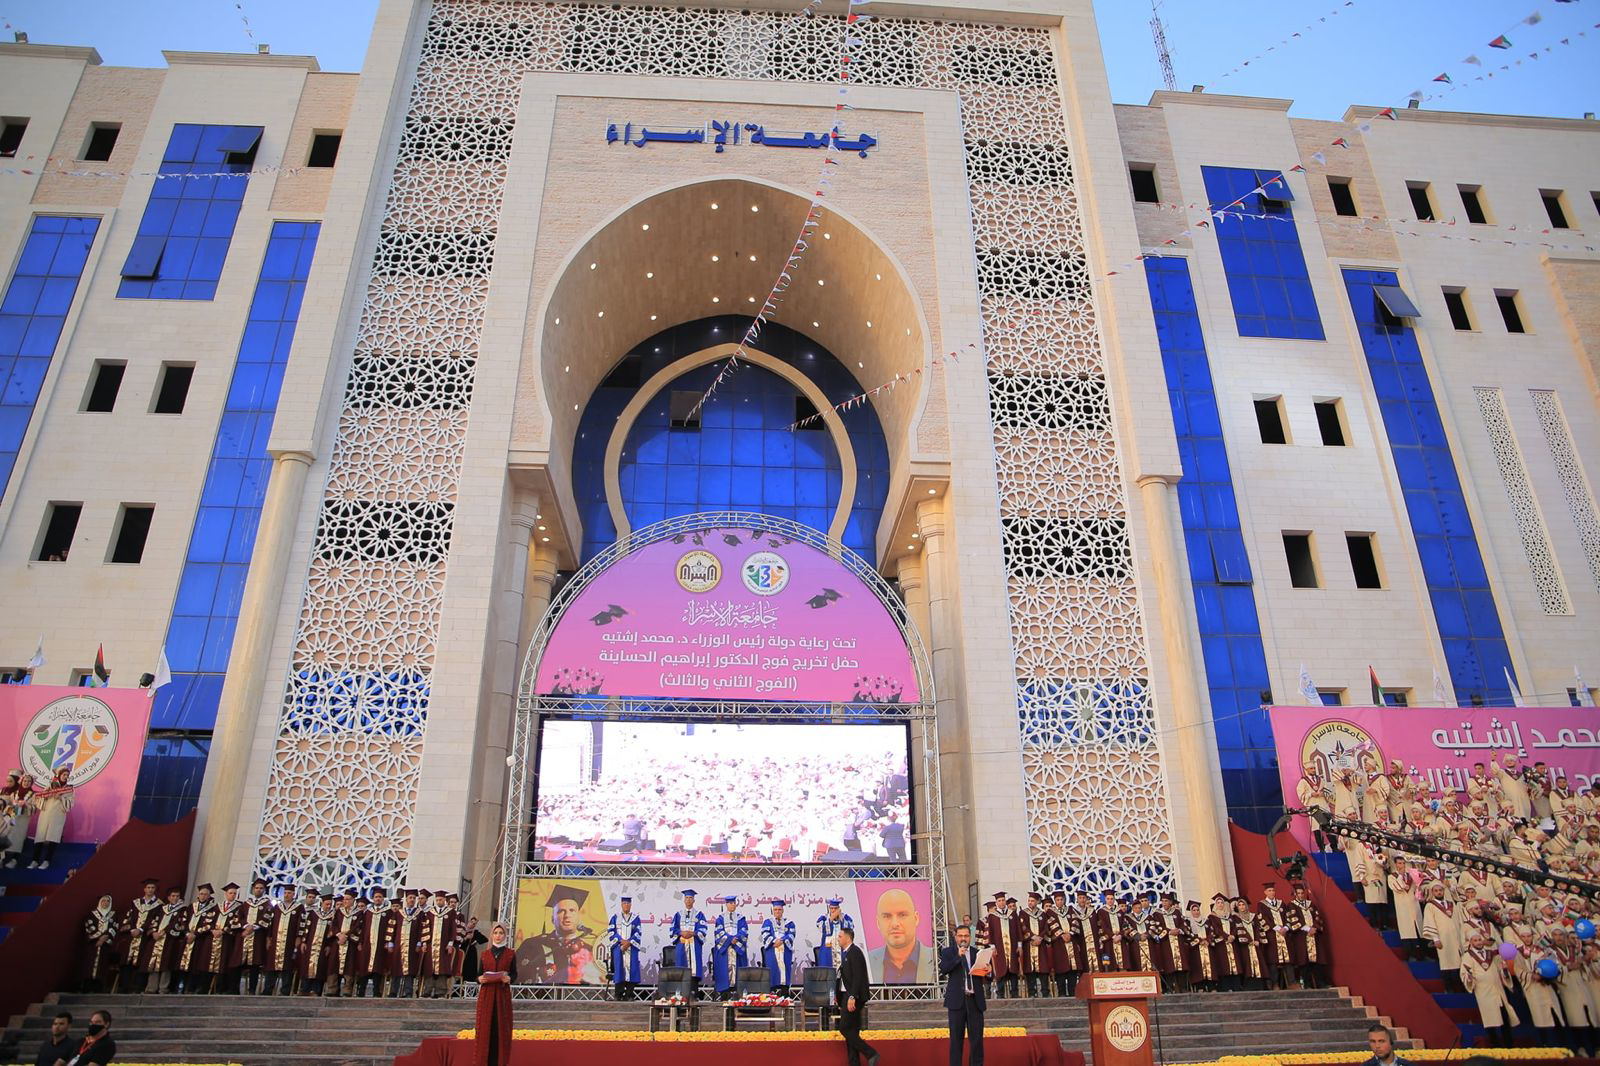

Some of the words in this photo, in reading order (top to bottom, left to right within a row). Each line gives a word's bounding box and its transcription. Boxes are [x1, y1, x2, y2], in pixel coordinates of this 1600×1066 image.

[606, 119, 740, 153] الإسراء
[744, 123, 878, 159] جامعة
[602, 630, 638, 646] إشتيه
[640, 634, 674, 643] محمد
[677, 634, 688, 644] د.
[691, 633, 730, 648] الوزراء
[733, 634, 765, 649] رئيس
[768, 635, 796, 649] دولة
[799, 636, 829, 651] رعاية
[832, 637, 856, 649] تحت
[599, 649, 657, 665] الحساينة
[660, 651, 711, 668] إبراهيم
[713, 653, 759, 668] الدكتور
[762, 655, 789, 670] فوج
[792, 655, 828, 671] تخريج
[831, 656, 859, 670] حفل
[659, 672, 709, 690] والثالث)
[713, 674, 753, 690] الثاني
[755, 676, 797, 692] (الفوج
[1432, 717, 1529, 758] إشتيه
[1531, 727, 1600, 749] حمد
[705, 892, 753, 908] فزركم
